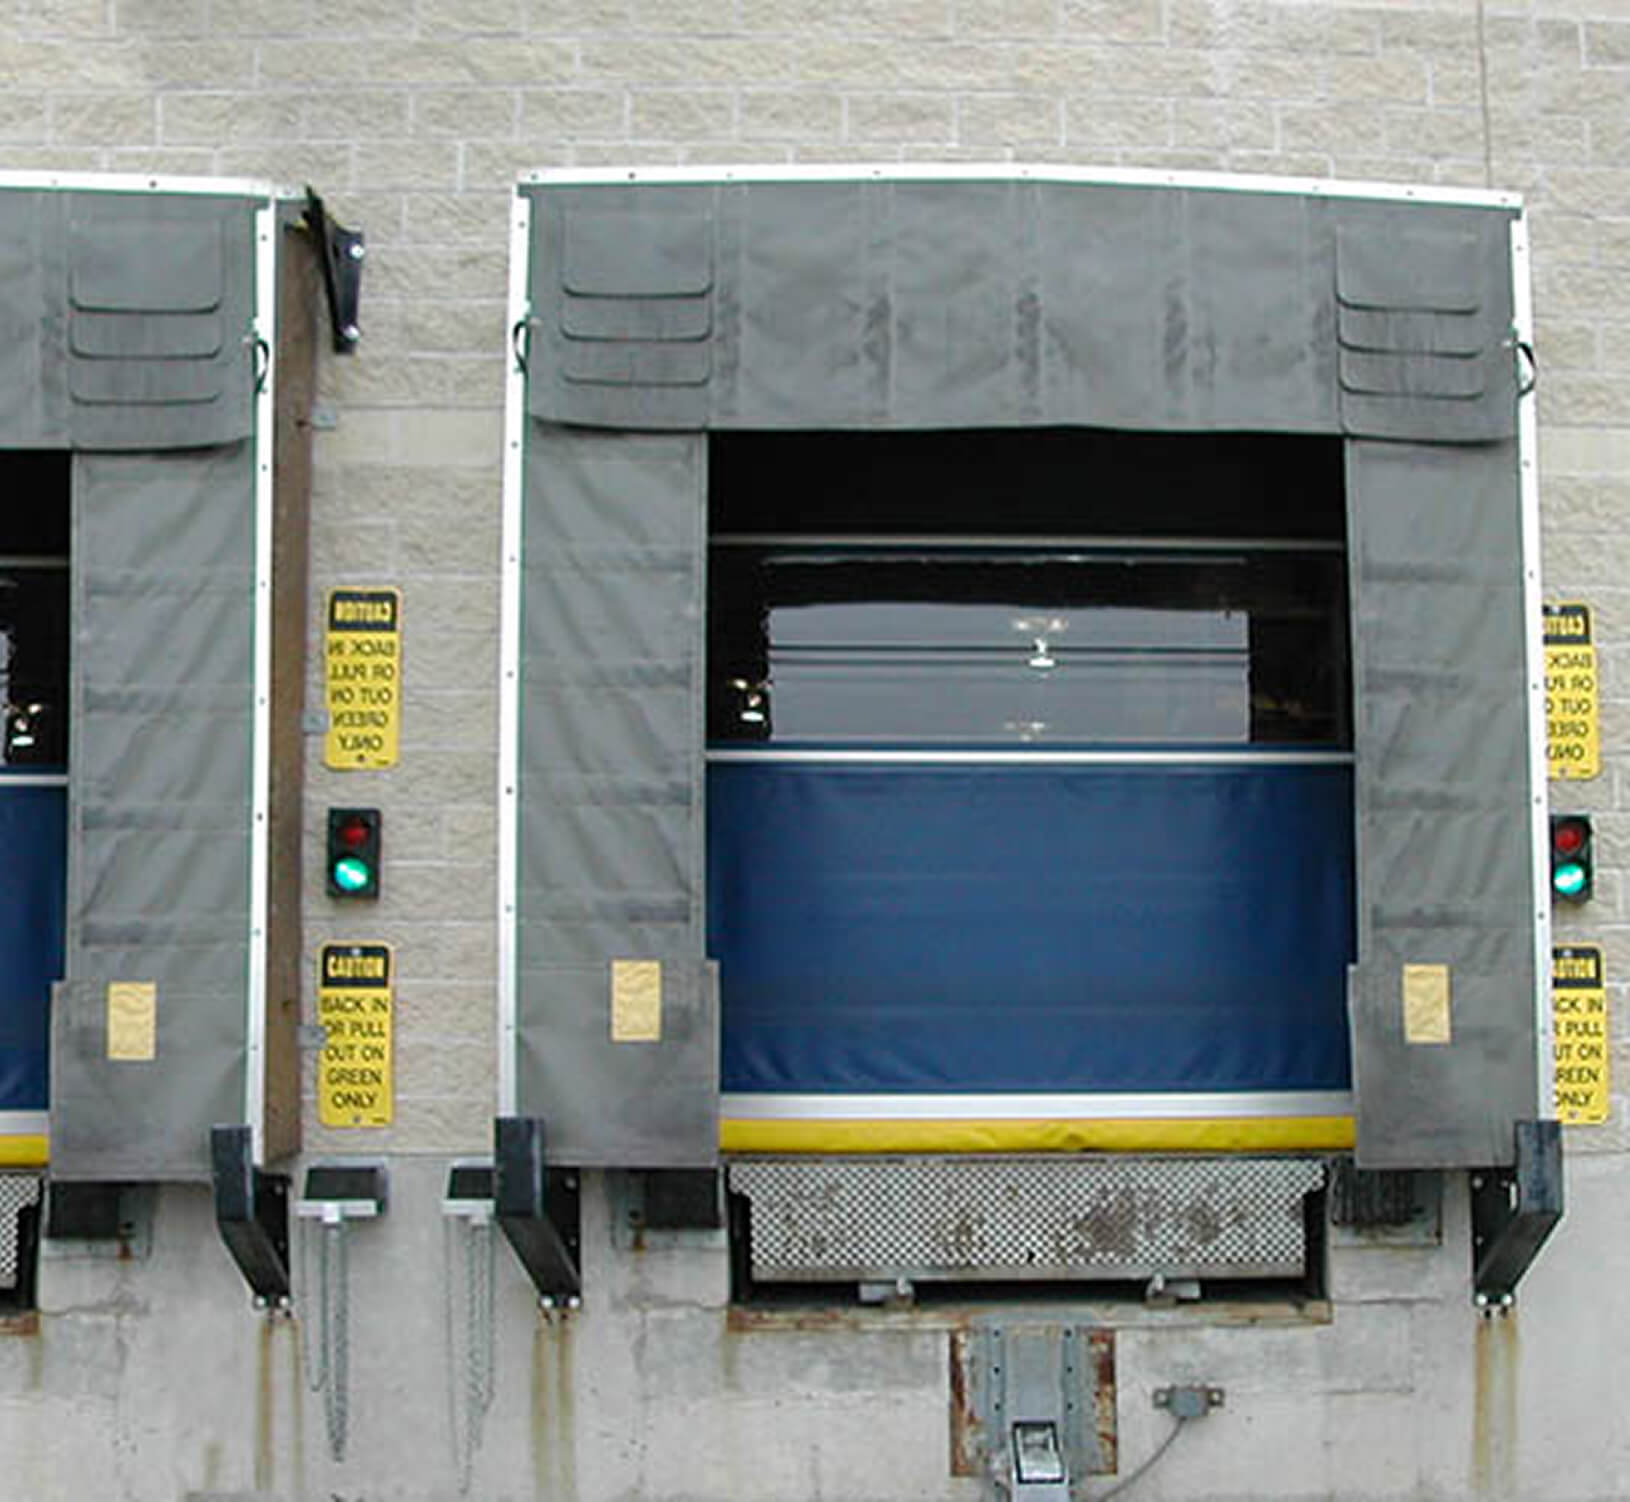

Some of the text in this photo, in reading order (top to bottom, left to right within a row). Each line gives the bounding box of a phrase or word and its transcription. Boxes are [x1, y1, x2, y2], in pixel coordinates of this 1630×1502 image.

[328, 956, 385, 978] CAUTION
[321, 996, 388, 1013] BACK IN
[1588, 998, 1604, 1013] IN
[324, 1019, 386, 1038] OR PULL
[1566, 1021, 1603, 1037] PULL
[325, 1044, 385, 1061] OUT ON
[1553, 1044, 1602, 1061] UT ON
[327, 1068, 382, 1085] GREEN
[1553, 1067, 1599, 1084] REEN
[332, 1091, 378, 1109] ONLY
